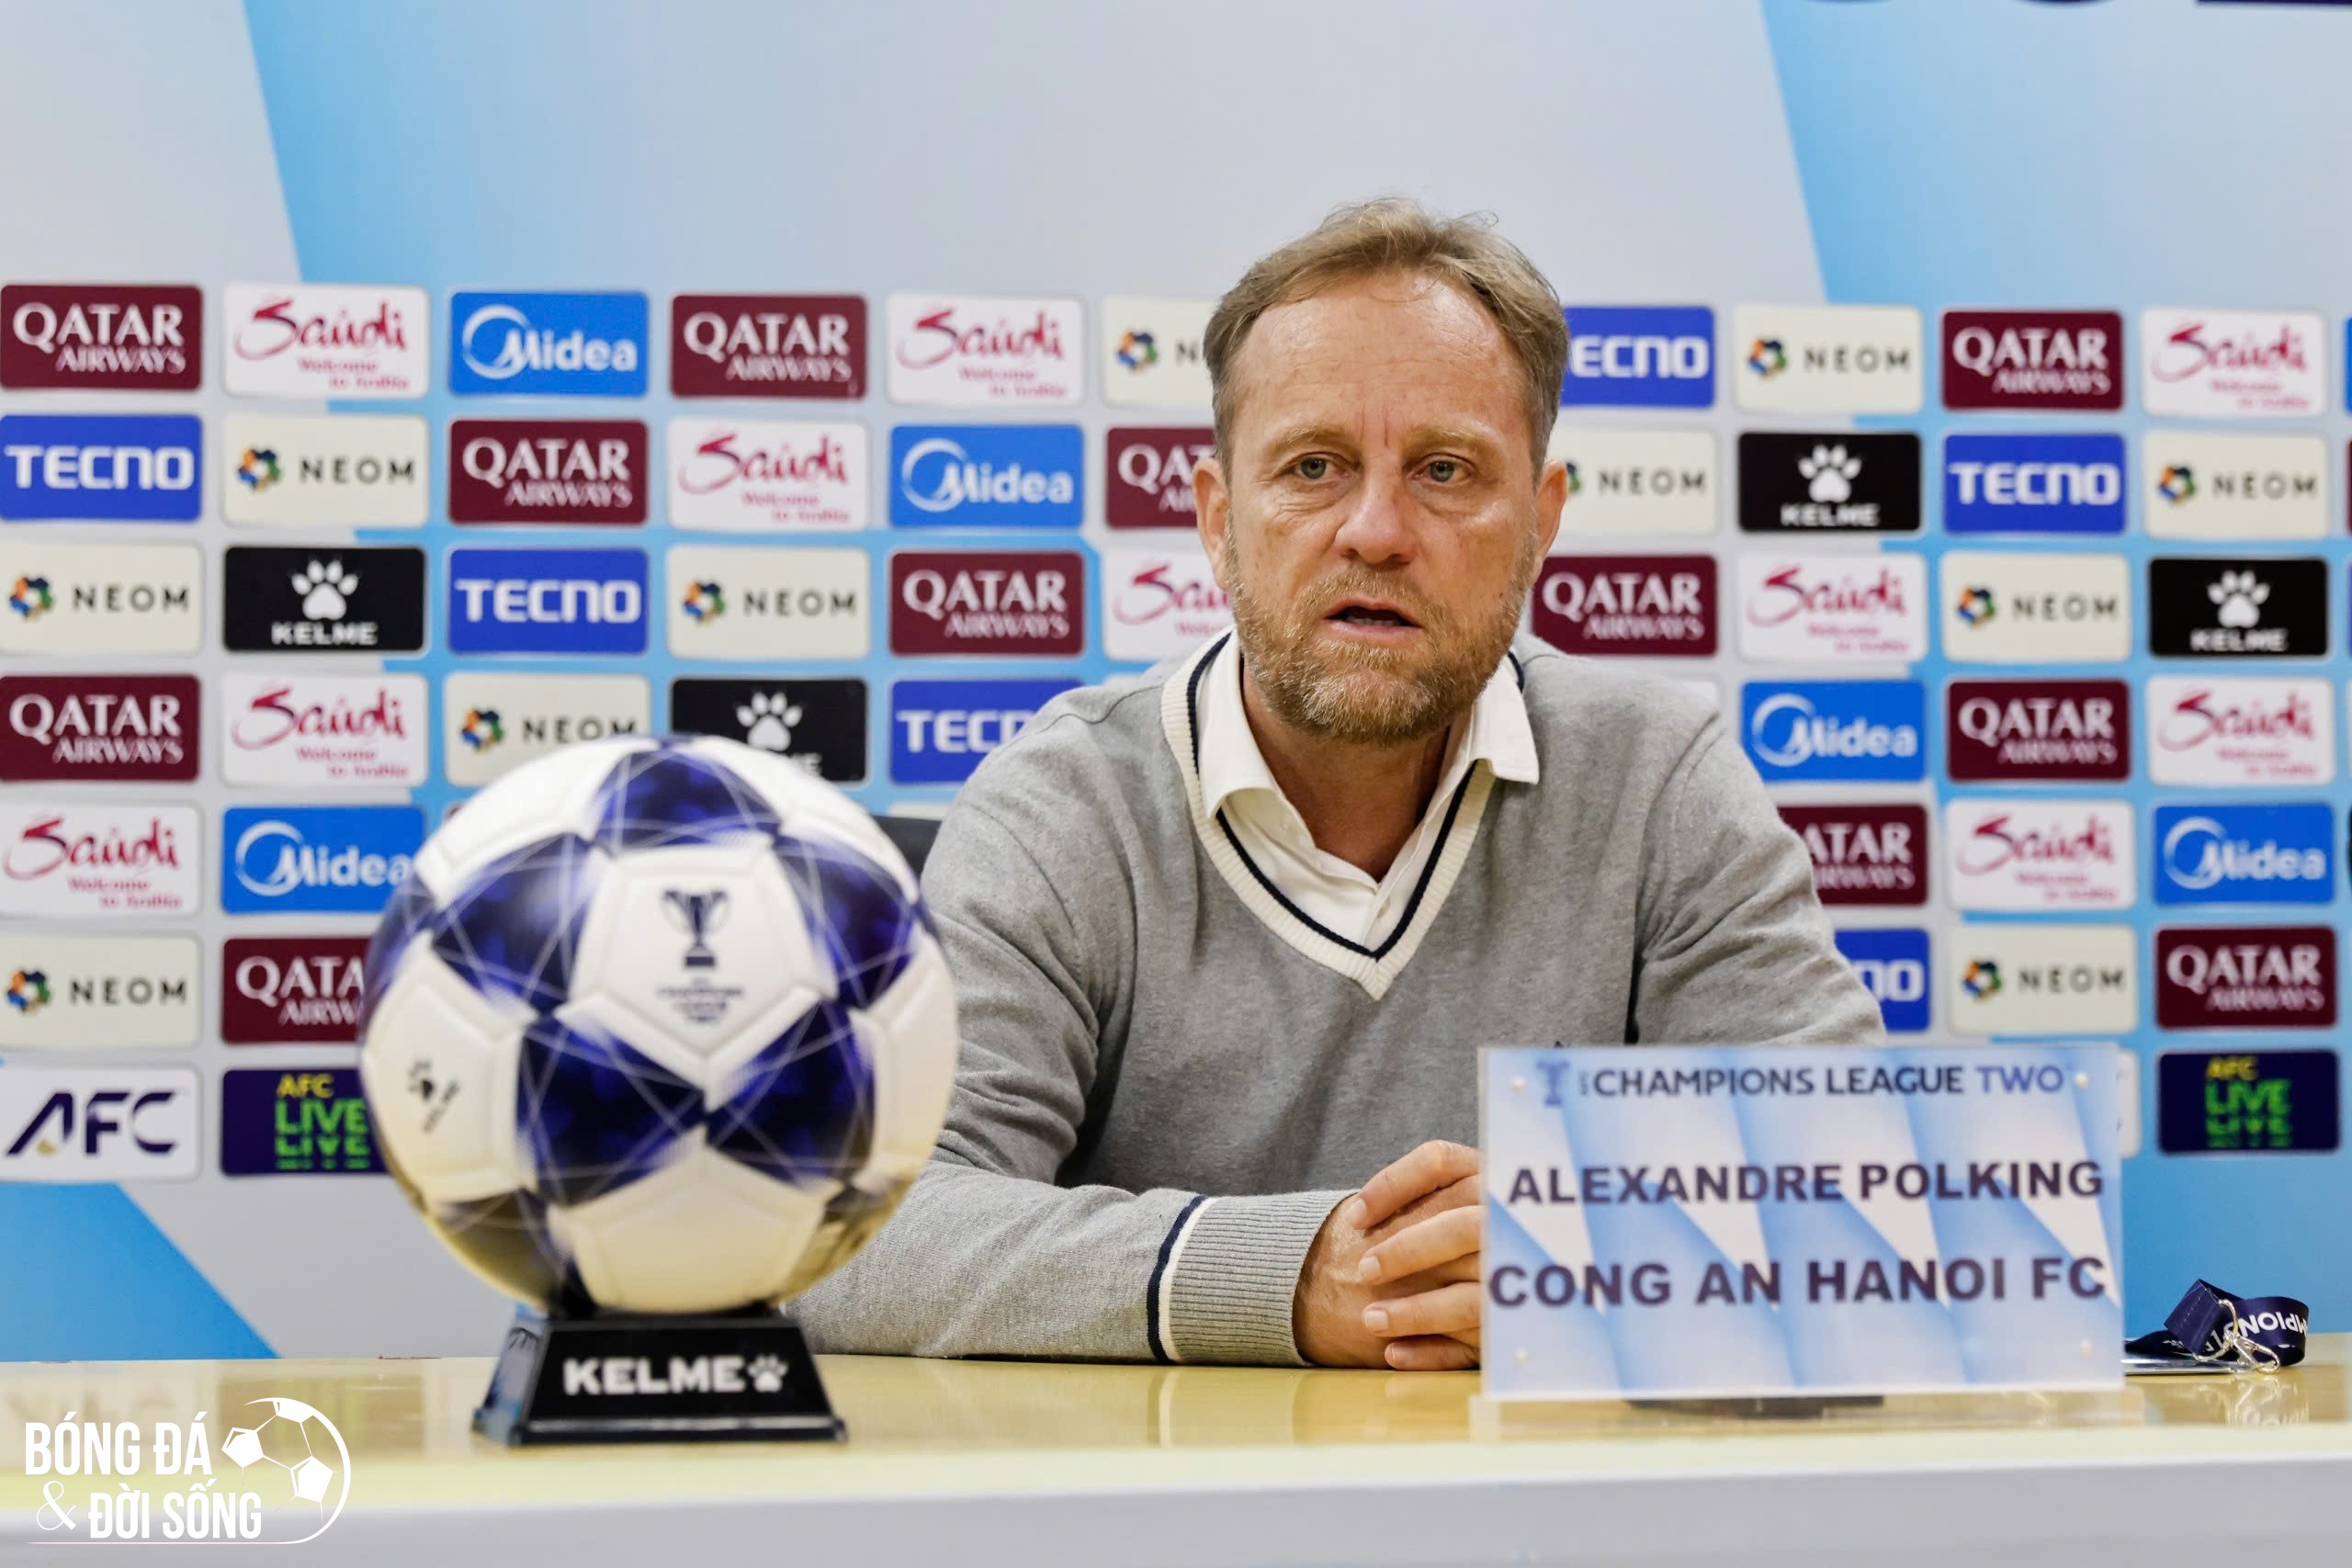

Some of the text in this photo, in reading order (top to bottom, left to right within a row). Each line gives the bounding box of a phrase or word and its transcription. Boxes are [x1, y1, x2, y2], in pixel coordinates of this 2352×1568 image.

[13, 302, 185, 353] QATAR
[470, 317, 638, 378] Midea
[684, 311, 850, 363] QATAR
[1570, 336, 1708, 378] ECNO
[1805, 349, 1910, 371] NEOM
[1952, 327, 2108, 376] QATAR
[4, 446, 195, 491] TECNO
[300, 457, 415, 483] NEOM
[461, 437, 631, 486] QATAR
[911, 451, 1074, 510] Midea
[1599, 469, 1705, 494] NEOM
[1948, 463, 2120, 506] TECNO
[2212, 476, 2318, 499] NEOM
[1781, 502, 1880, 528] KELME
[73, 585, 189, 612] NEOM
[457, 580, 642, 624] TECNO
[743, 590, 857, 615] NEOM
[902, 569, 1067, 620] QATAR
[1543, 571, 1702, 622] QATAR
[2012, 596, 2117, 620] NEOM
[271, 622, 379, 646] KELME
[9, 694, 182, 744] QATAR
[1762, 705, 1919, 761] Midea
[1958, 697, 2114, 745] QATAR
[246, 831, 415, 893] Midea
[1804, 822, 1912, 865] ATAR
[2175, 827, 2326, 886] Midea
[235, 955, 366, 1008] QATA
[2018, 969, 2124, 993] NEOM
[2166, 944, 2322, 994] QATAR
[70, 978, 187, 1006] NEOM
[277, 1074, 334, 1099] AFC
[1594, 1067, 1815, 1100] CHAMPIONS
[1826, 1066, 1963, 1095] LEAGUE
[1975, 1066, 2064, 1094] TWO
[6, 1091, 179, 1156] AFC
[276, 1098, 369, 1134] LIVE
[1509, 1158, 2103, 1206] ALEXANDRE POLKING
[1488, 1255, 2106, 1309] CONG AN HANOI FC
[563, 1355, 745, 1396] KELME
